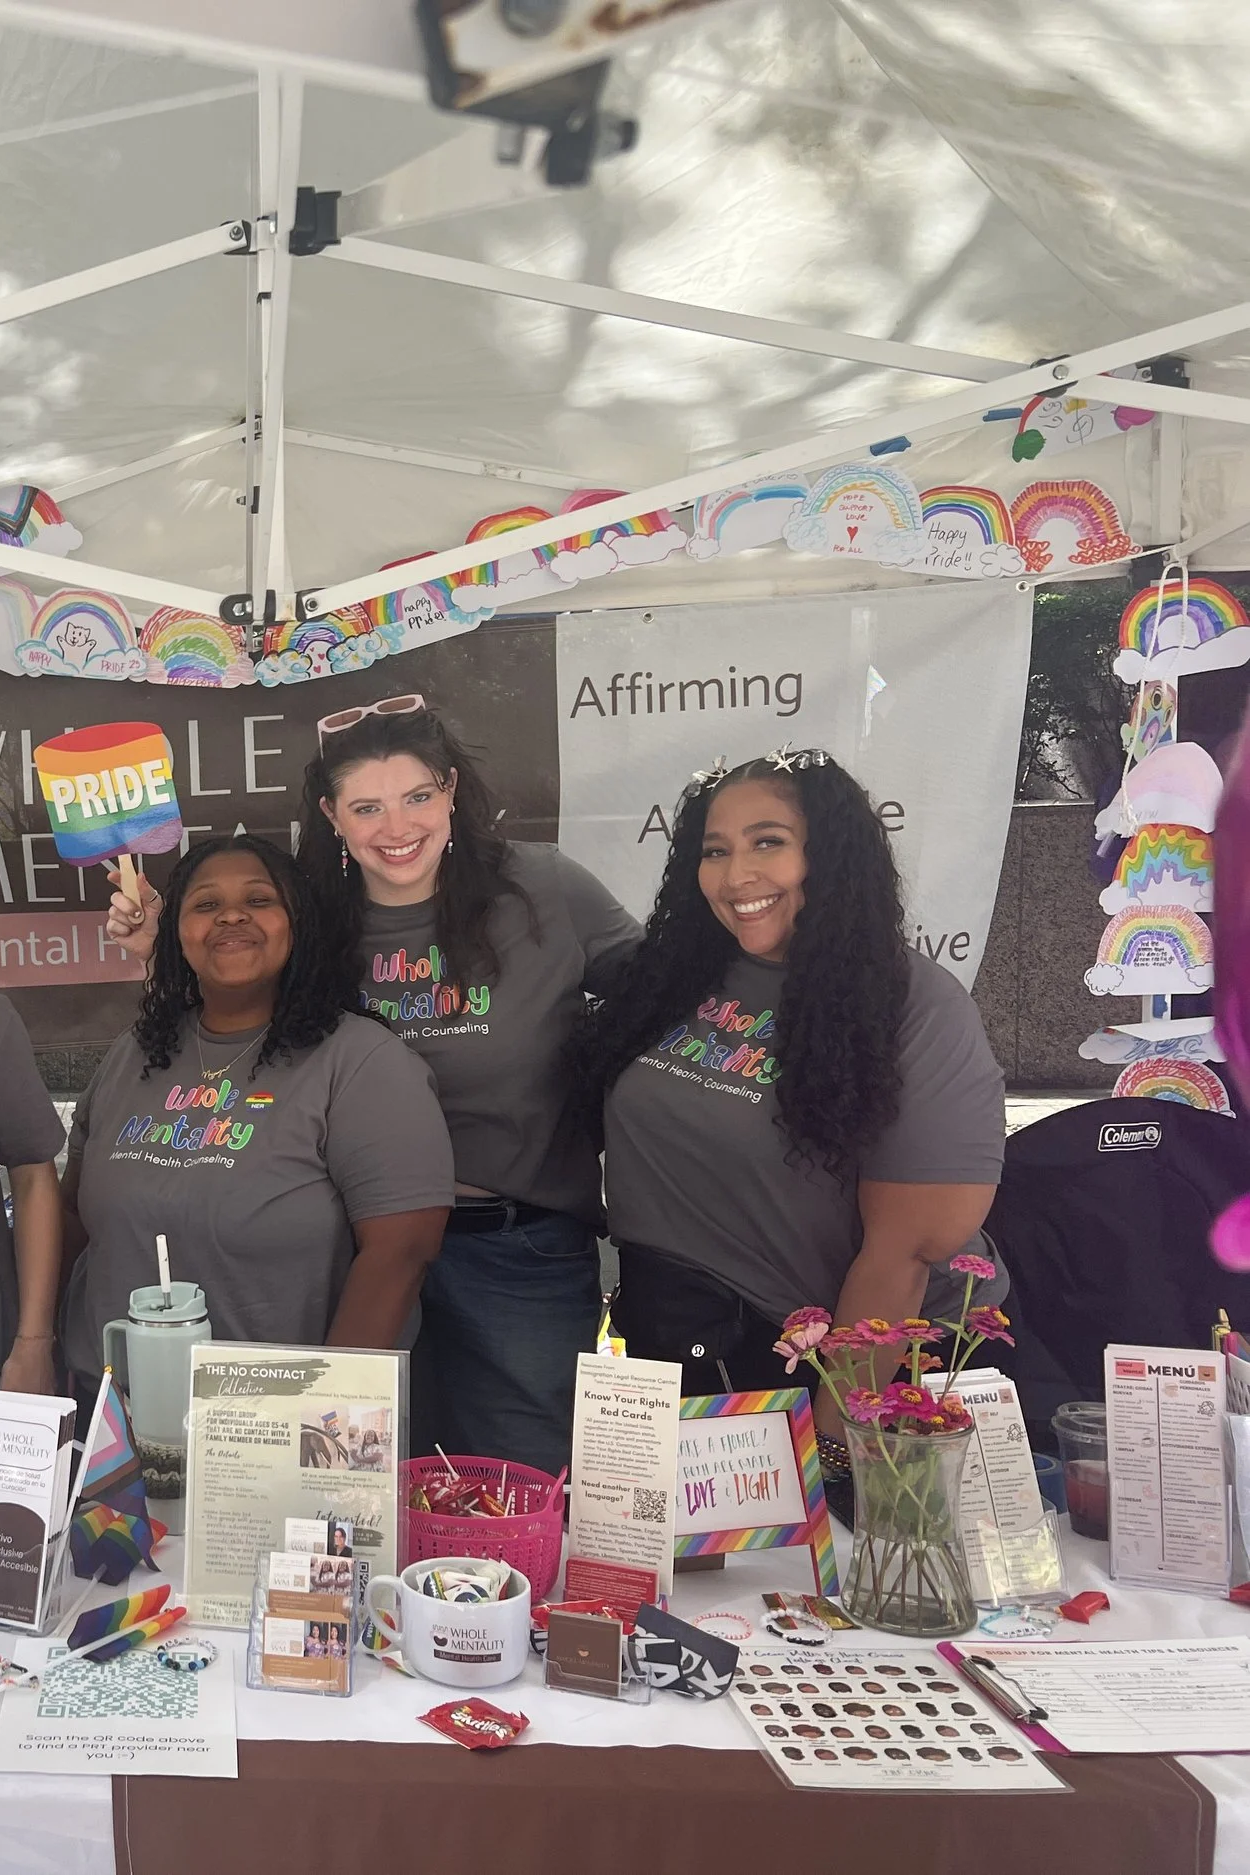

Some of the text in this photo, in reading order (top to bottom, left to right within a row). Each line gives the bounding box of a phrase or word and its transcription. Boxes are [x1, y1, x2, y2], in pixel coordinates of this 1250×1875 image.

[928, 521, 968, 549] Happy
[404, 596, 432, 613] happy
[101, 659, 124, 673] PRIDE
[570, 665, 804, 719] Affirming
[49, 757, 172, 824] PRIDE
[115, 1114, 255, 1151] Mentality
[109, 1150, 235, 1169] Mental Health Counseling
[206, 1364, 307, 1380] THE NO CONTACT
[1147, 1364, 1197, 1379] MENÚ
[217, 1376, 267, 1396] Collective
[584, 1390, 672, 1409] Know Your Rights
[961, 1391, 999, 1407] MENU
[600, 1406, 653, 1421] Red Cards
[1, 1431, 35, 1446] WHOLE
[205, 1434, 291, 1446] FAMILY MEMBER OR MEMBERS
[1, 1444, 52, 1459] MENTALITY
[678, 1438, 701, 1460] AKE
[708, 1437, 715, 1452] A
[581, 1479, 631, 1493] Need another
[685, 1476, 717, 1517] LOVE
[733, 1467, 782, 1507] LIGHT
[584, 1490, 624, 1503] language?
[0, 1558, 40, 1575] Accesible
[450, 1627, 488, 1641] WHOLE
[450, 1638, 506, 1651] MENTALITY
[1099, 1648, 1138, 1656] HEALTH
[1177, 1645, 1240, 1654] RESOURCES
[439, 1652, 498, 1662] Mental Health Care
[450, 1711, 508, 1741] Skittles
[25, 1734, 205, 1744] Scan the QR code above
[36, 1742, 65, 1750] find
[110, 1745, 174, 1754] provider
[85, 1751, 114, 1760] you
